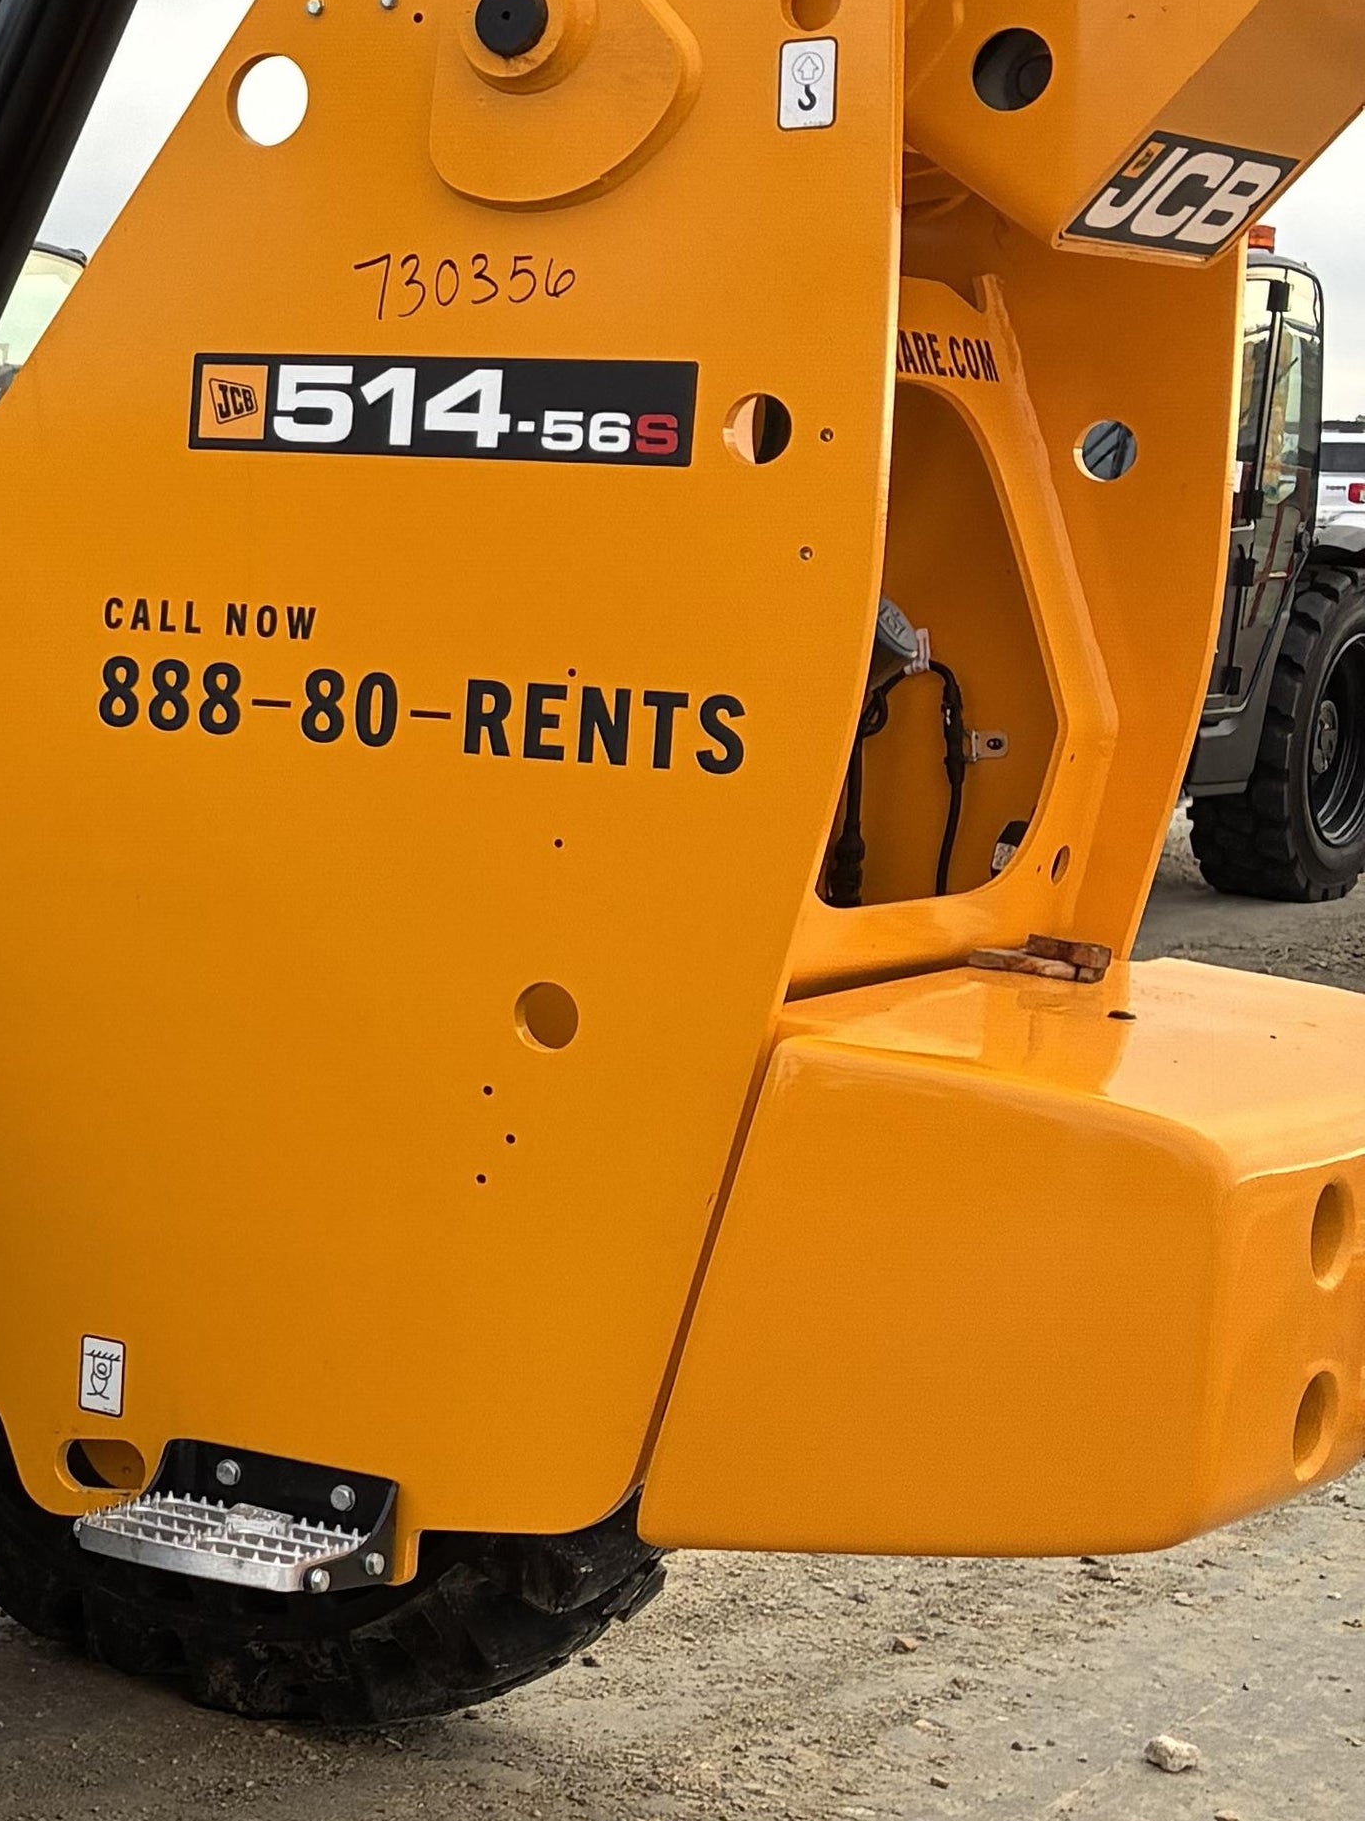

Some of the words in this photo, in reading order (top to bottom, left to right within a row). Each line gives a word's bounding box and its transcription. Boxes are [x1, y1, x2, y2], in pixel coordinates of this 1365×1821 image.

[1084, 138, 1286, 248] JCB
[354, 251, 577, 322] 730356
[895, 328, 1000, 383] ARE.COM
[216, 383, 255, 418] JCB
[102, 596, 202, 636] CALL
[225, 601, 318, 642] NOW
[98, 654, 747, 777] 888-80-RENTS
